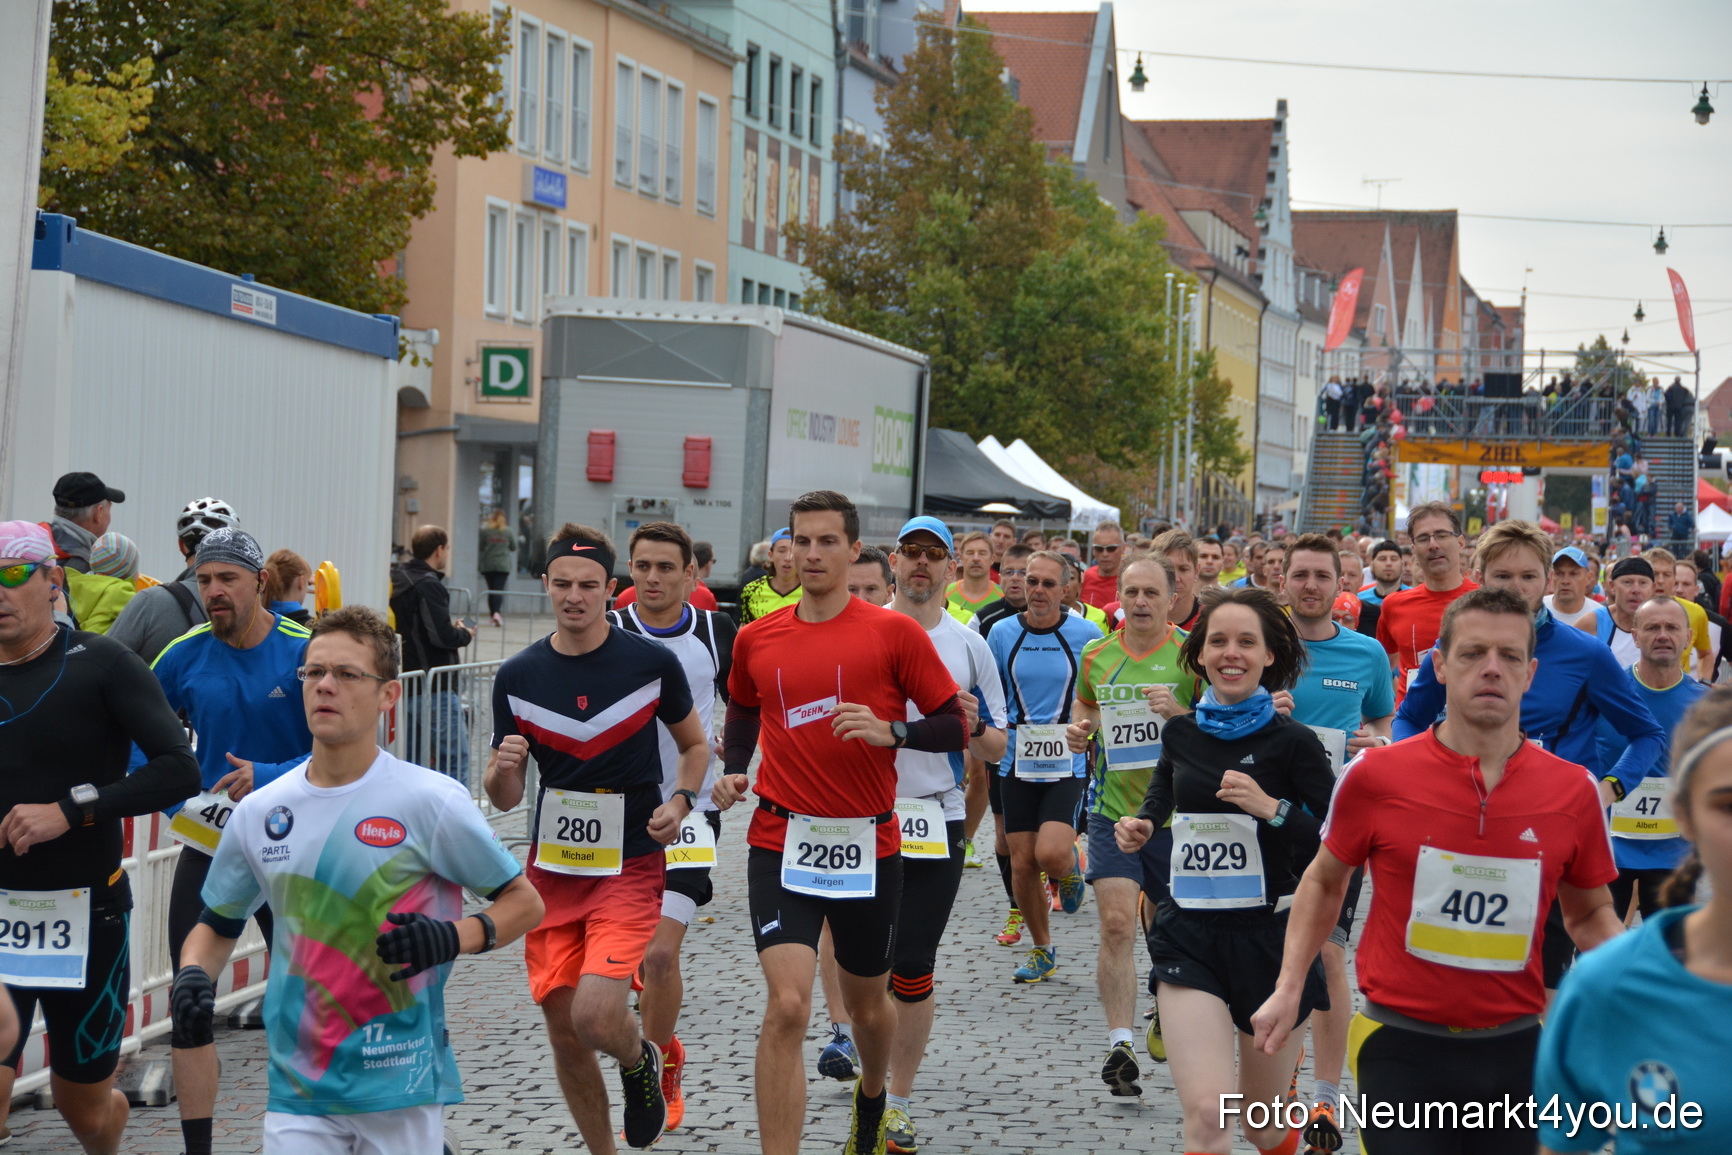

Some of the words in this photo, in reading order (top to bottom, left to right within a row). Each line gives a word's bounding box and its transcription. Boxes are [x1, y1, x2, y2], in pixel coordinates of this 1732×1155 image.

[786, 407, 808, 439] OFFICE
[808, 410, 837, 444] INDUSTRY
[837, 416, 861, 448] LOUNGE
[871, 405, 914, 477] BOCK
[1479, 444, 1528, 463] ZIEL
[1322, 678, 1359, 691] BOCK
[800, 705, 824, 719] DEHN
[1111, 721, 1160, 745] 2750
[1024, 741, 1064, 757] 2700
[568, 799, 598, 808] BOCK
[1635, 796, 1662, 816] 47
[361, 823, 401, 840] Hervis
[556, 815, 602, 844] 280
[818, 825, 850, 834] BOCK
[901, 817, 929, 838] 49
[1195, 822, 1230, 831] BOCK
[1635, 821, 1658, 829] Albert
[262, 845, 291, 856] PARTL
[561, 849, 595, 861] Michael
[796, 841, 862, 870] 2269
[900, 843, 925, 851] arkus
[261, 854, 290, 864] Neumarkt
[1180, 842, 1247, 871] 2929
[1464, 866, 1507, 879] BOCK
[811, 876, 844, 888] Jürgen
[19, 899, 57, 909] BOCK
[1440, 889, 1509, 927] 402
[0, 918, 72, 950] 2913
[362, 1022, 393, 1044] 17.
[362, 1035, 426, 1057] Neumarkter
[363, 1051, 418, 1070] Stadtlauf
